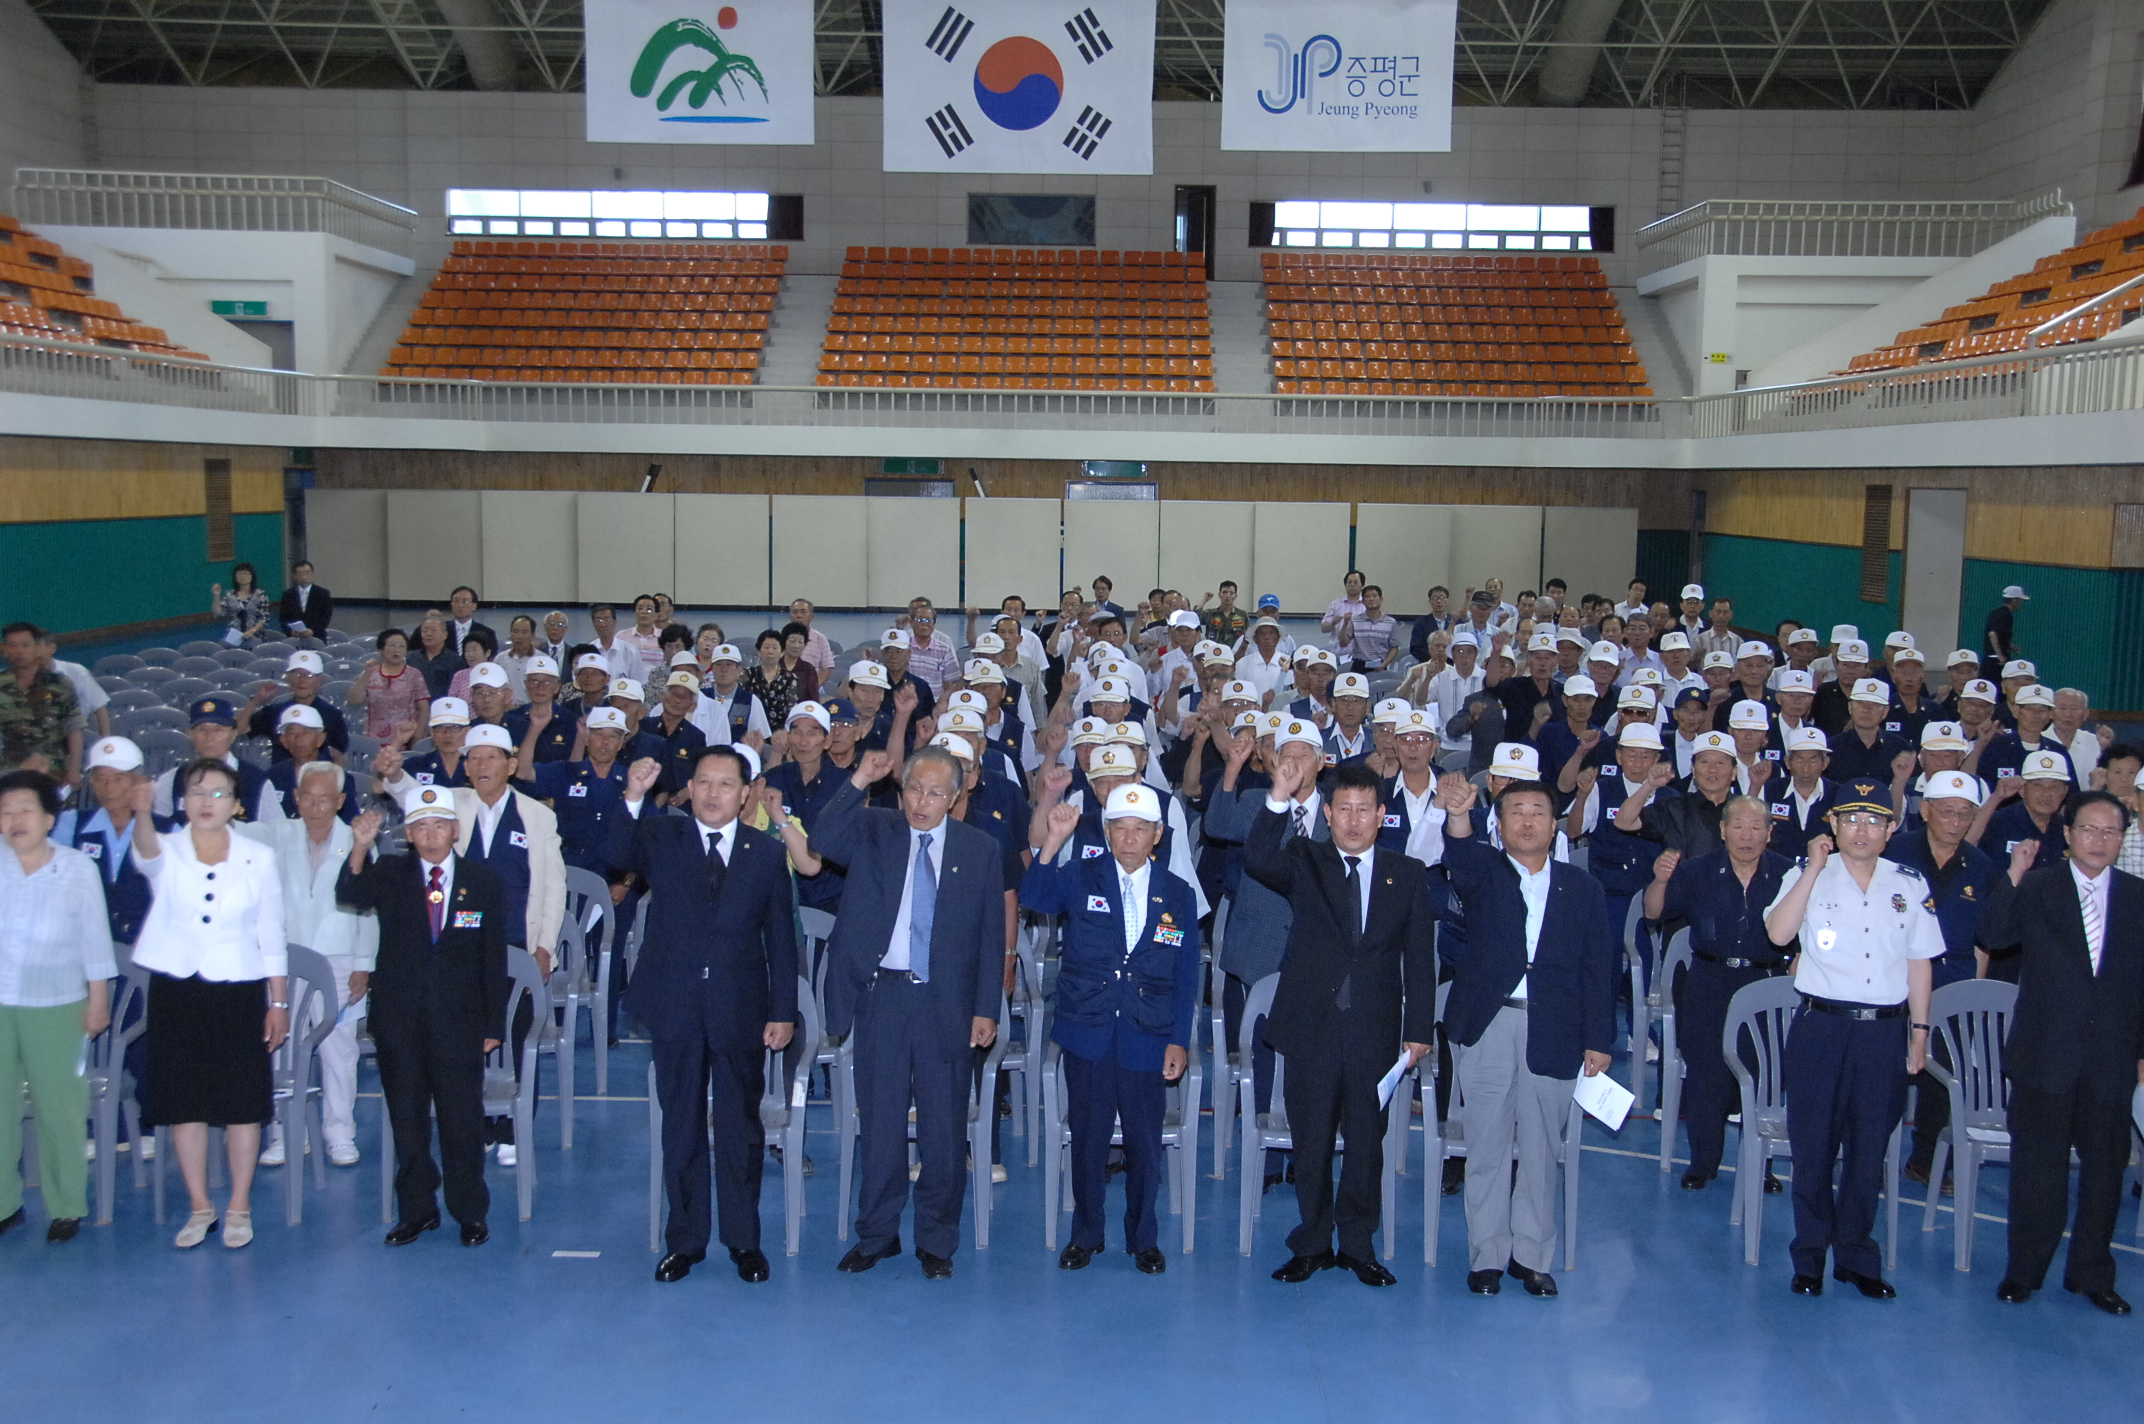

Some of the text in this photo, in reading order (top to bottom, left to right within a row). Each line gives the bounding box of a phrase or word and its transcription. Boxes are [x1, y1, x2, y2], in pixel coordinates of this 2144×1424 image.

[1345, 56, 1420, 97] 증평군
[1317, 102, 1418, 119] Jeung Pyeong
